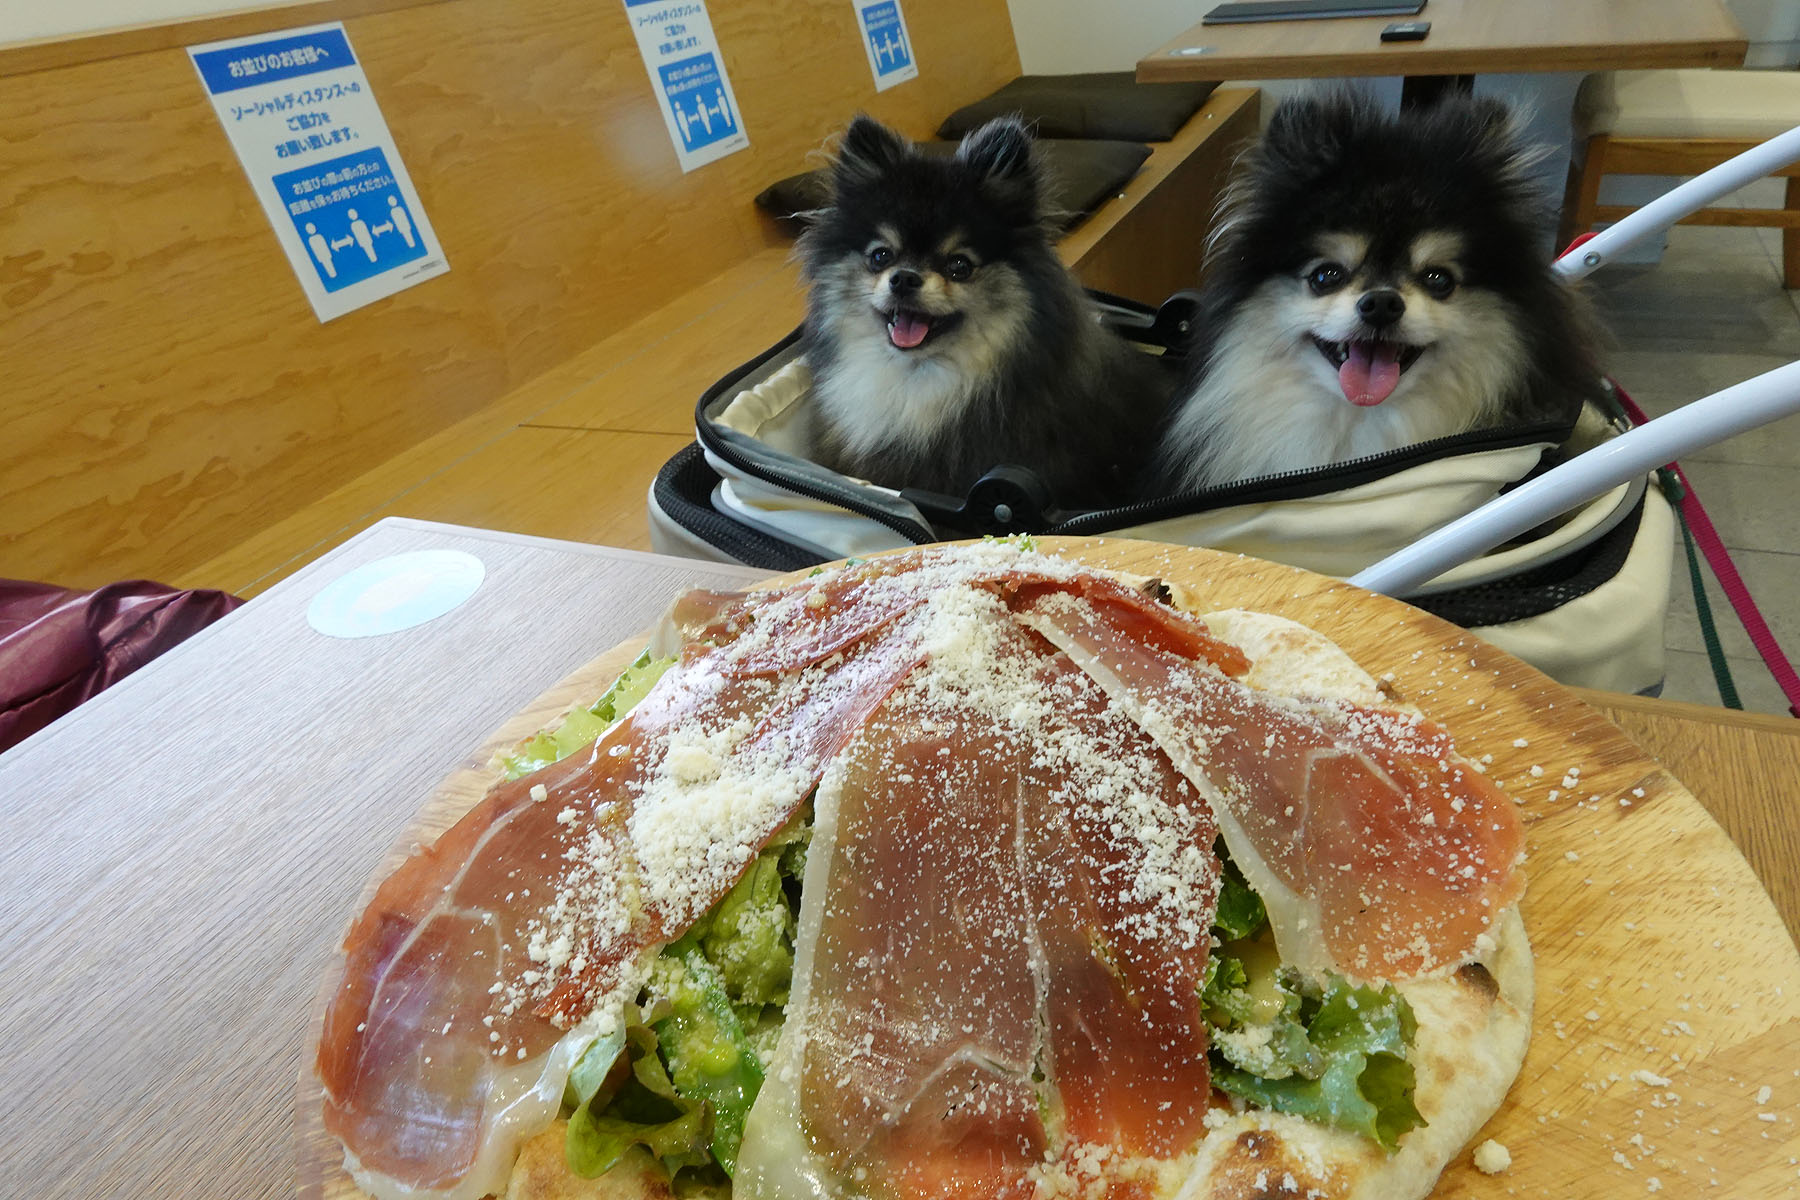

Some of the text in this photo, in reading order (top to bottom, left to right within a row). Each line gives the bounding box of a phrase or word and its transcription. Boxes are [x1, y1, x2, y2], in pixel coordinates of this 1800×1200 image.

[228, 45, 329, 78] お並びのお客様へ
[231, 82, 361, 121] ソーシャルディスタンスへの
[286, 112, 331, 131] ご協力を
